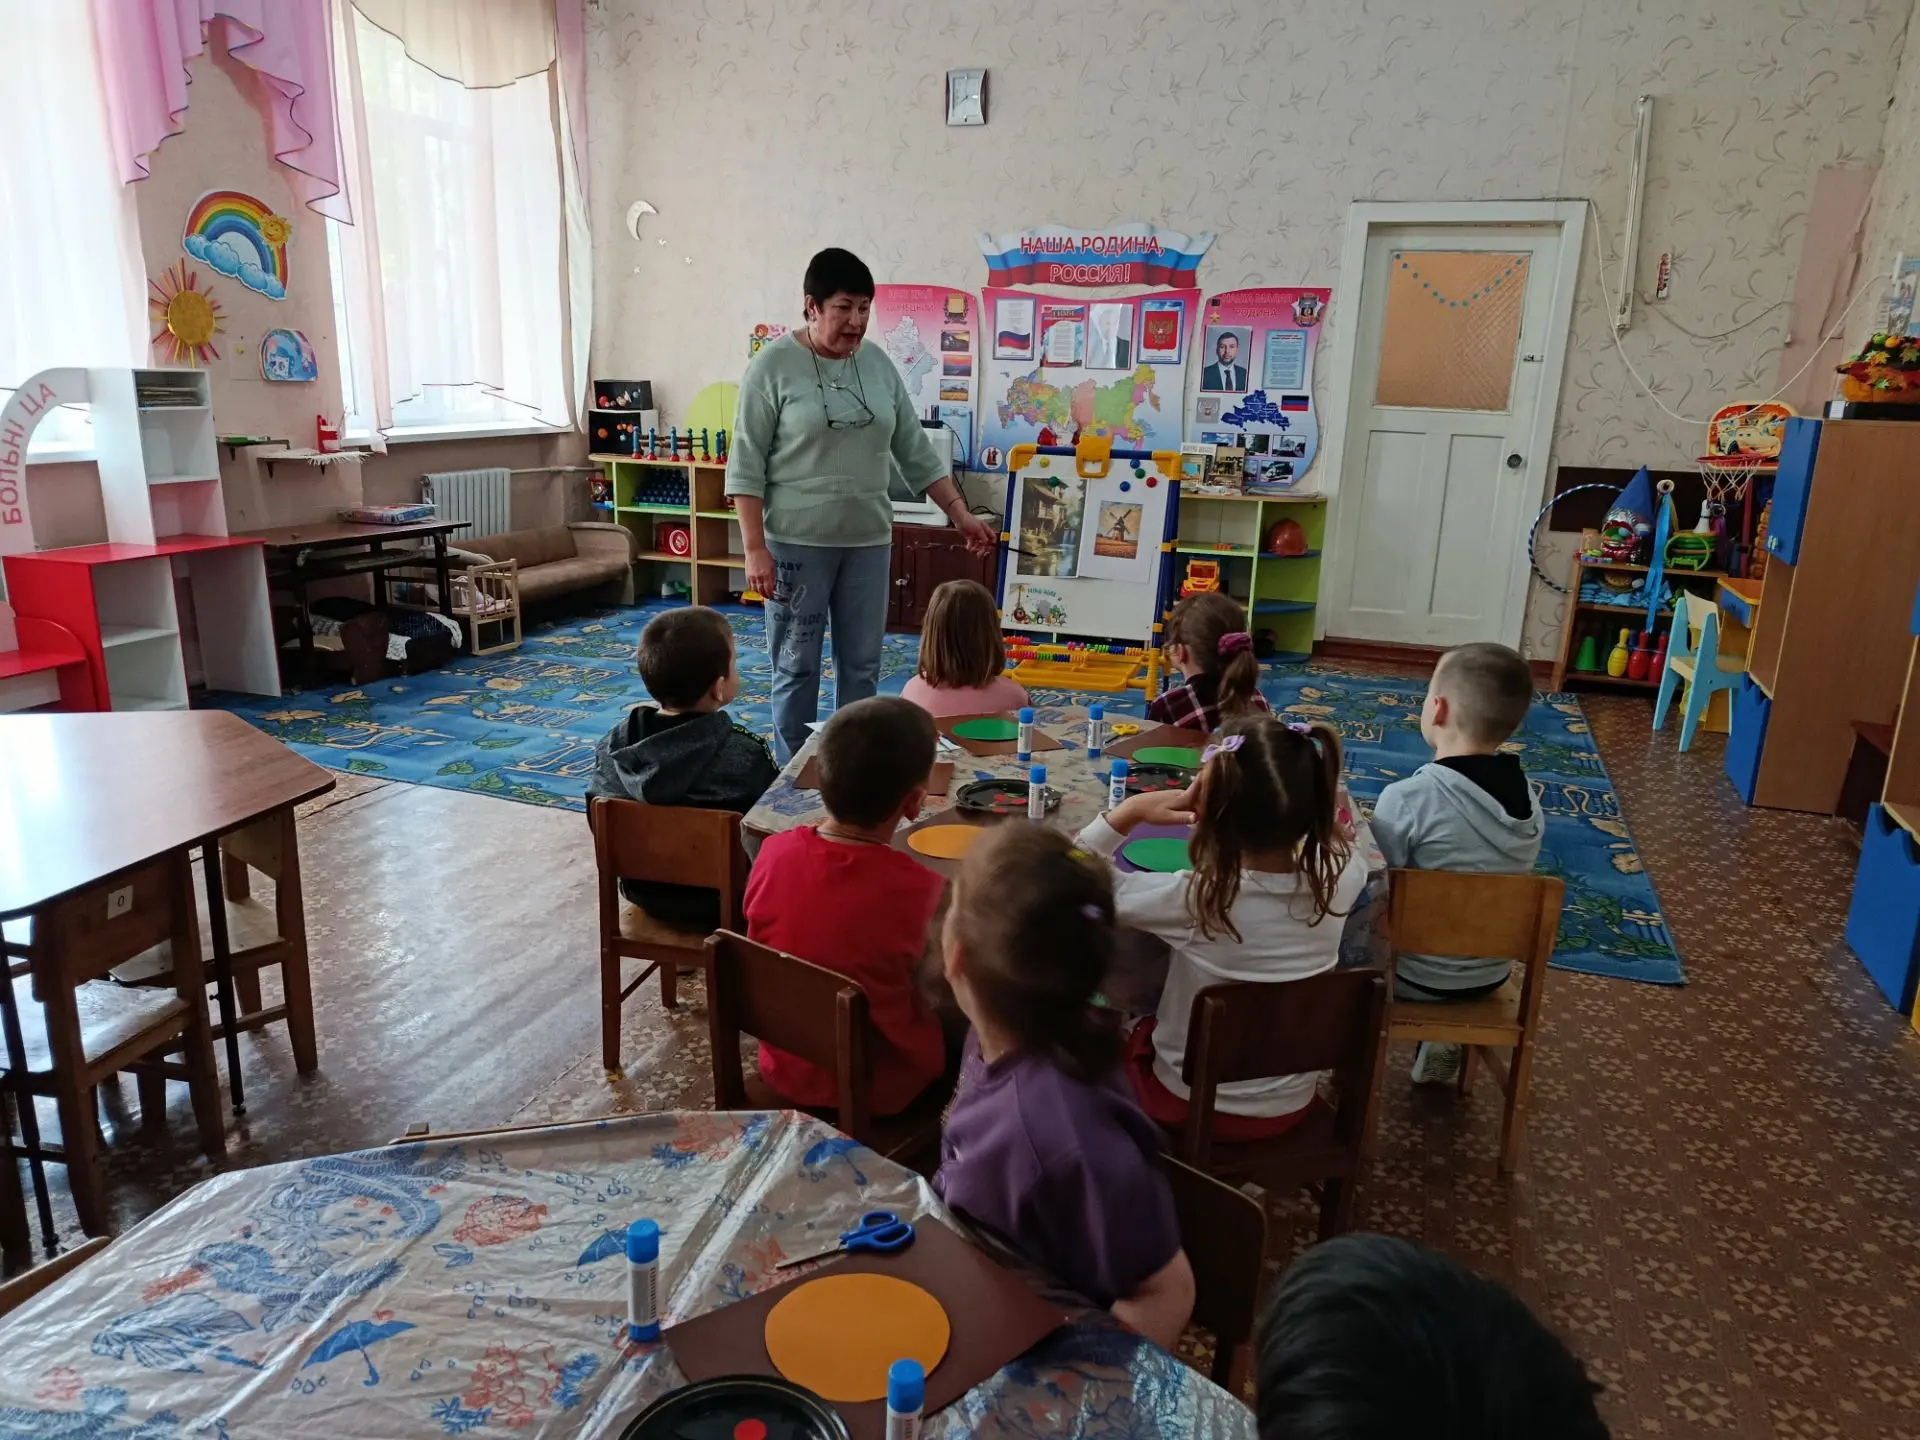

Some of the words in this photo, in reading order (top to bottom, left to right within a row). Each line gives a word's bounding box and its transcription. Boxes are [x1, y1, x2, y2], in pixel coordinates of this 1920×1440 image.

[1020, 236, 1075, 254] НАША
[1080, 236, 1165, 257] РОДИНА,
[1050, 264, 1131, 283] РОССИЯ!
